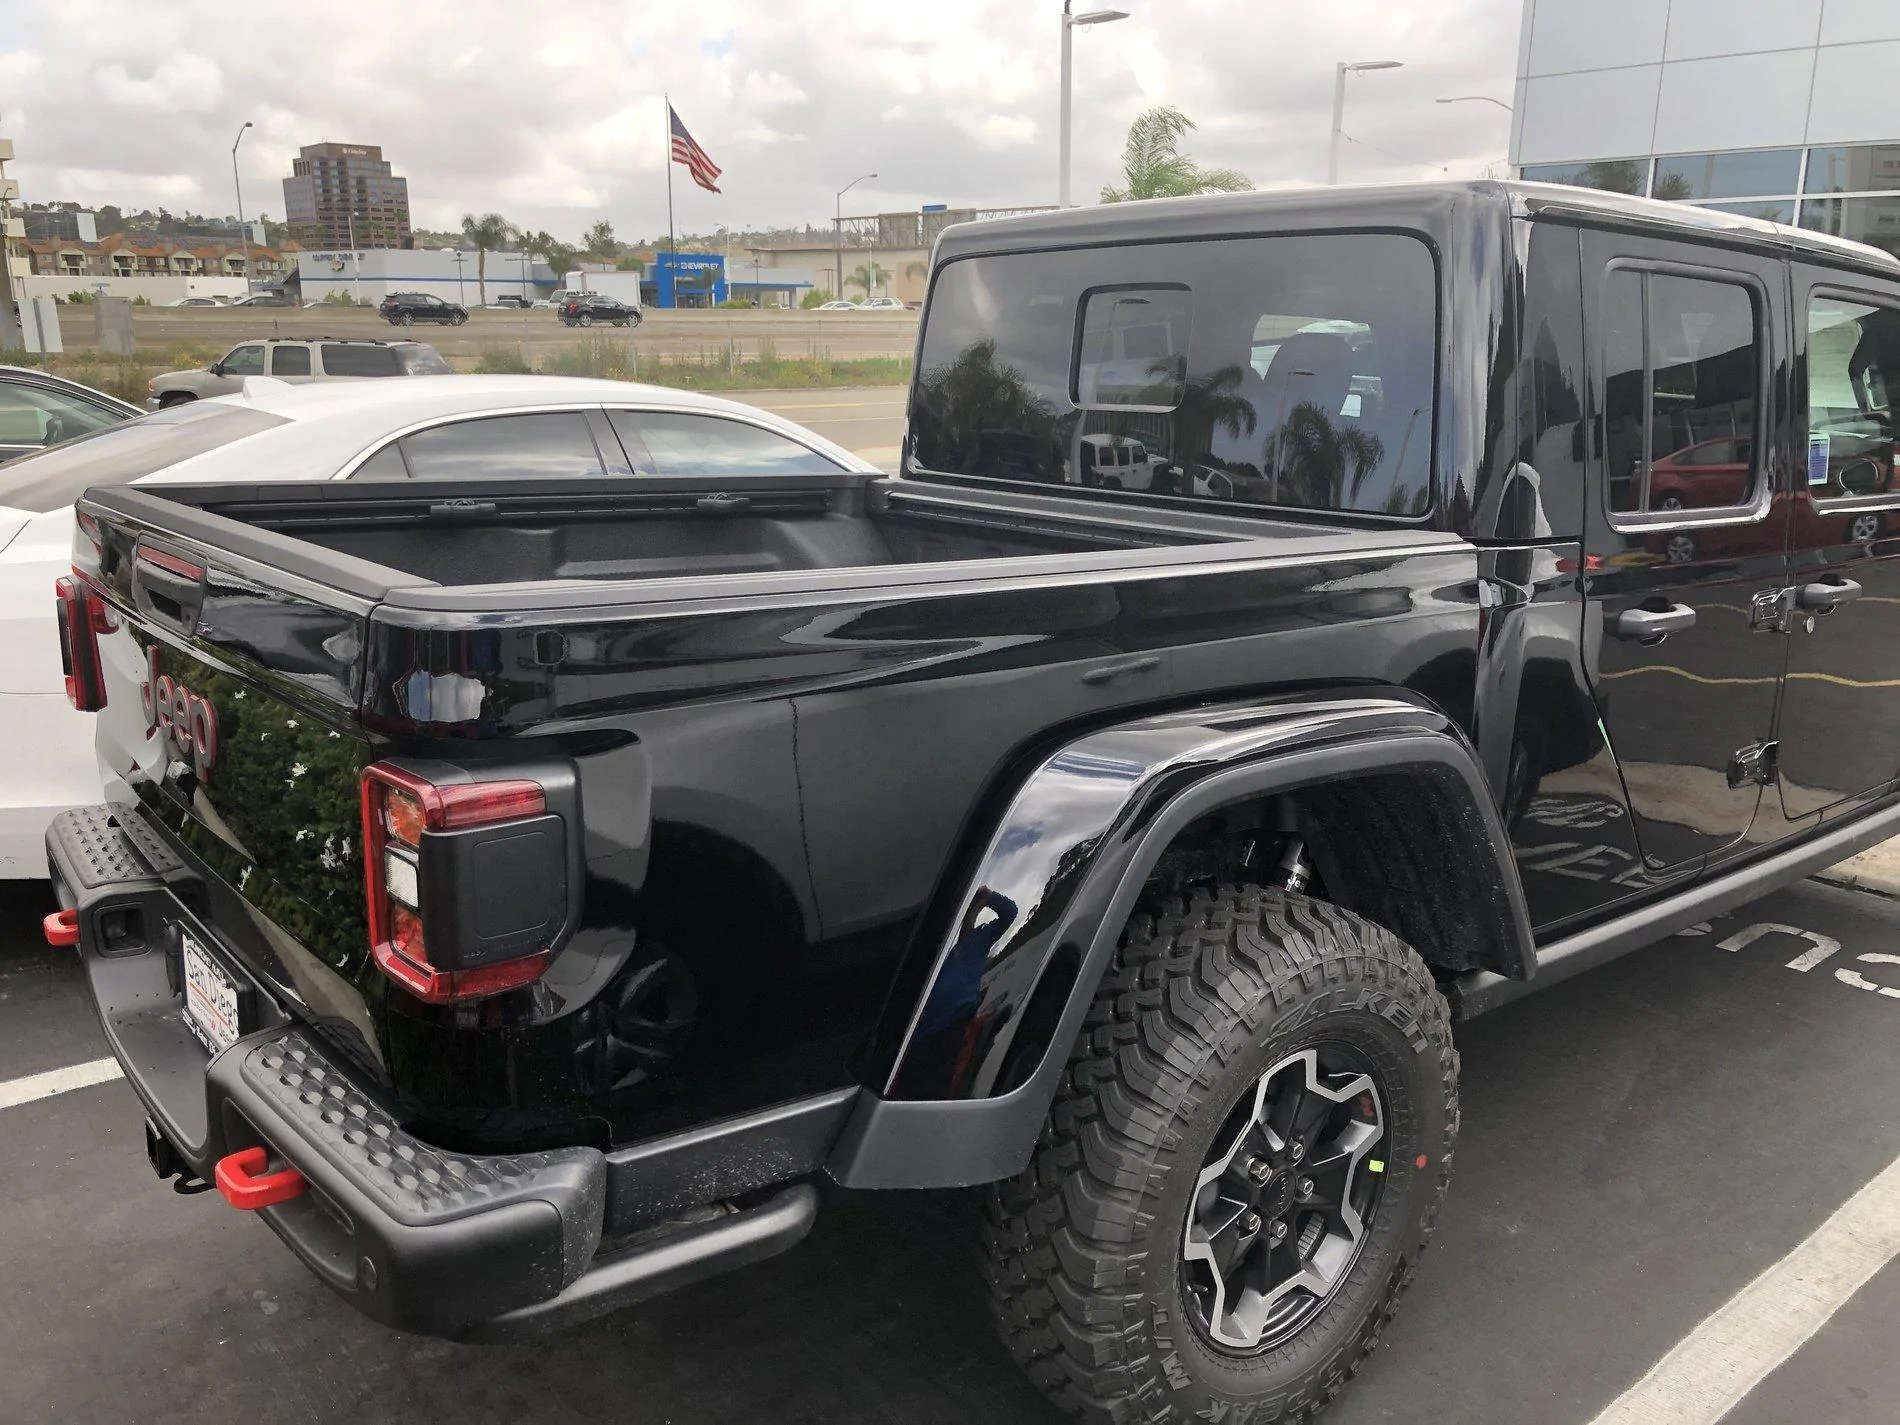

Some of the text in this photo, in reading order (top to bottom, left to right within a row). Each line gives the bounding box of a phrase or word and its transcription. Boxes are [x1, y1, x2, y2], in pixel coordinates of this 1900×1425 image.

[140, 644, 217, 783] Jeep
[186, 949, 207, 994] San
[1260, 987, 1429, 1054] FALKEN
